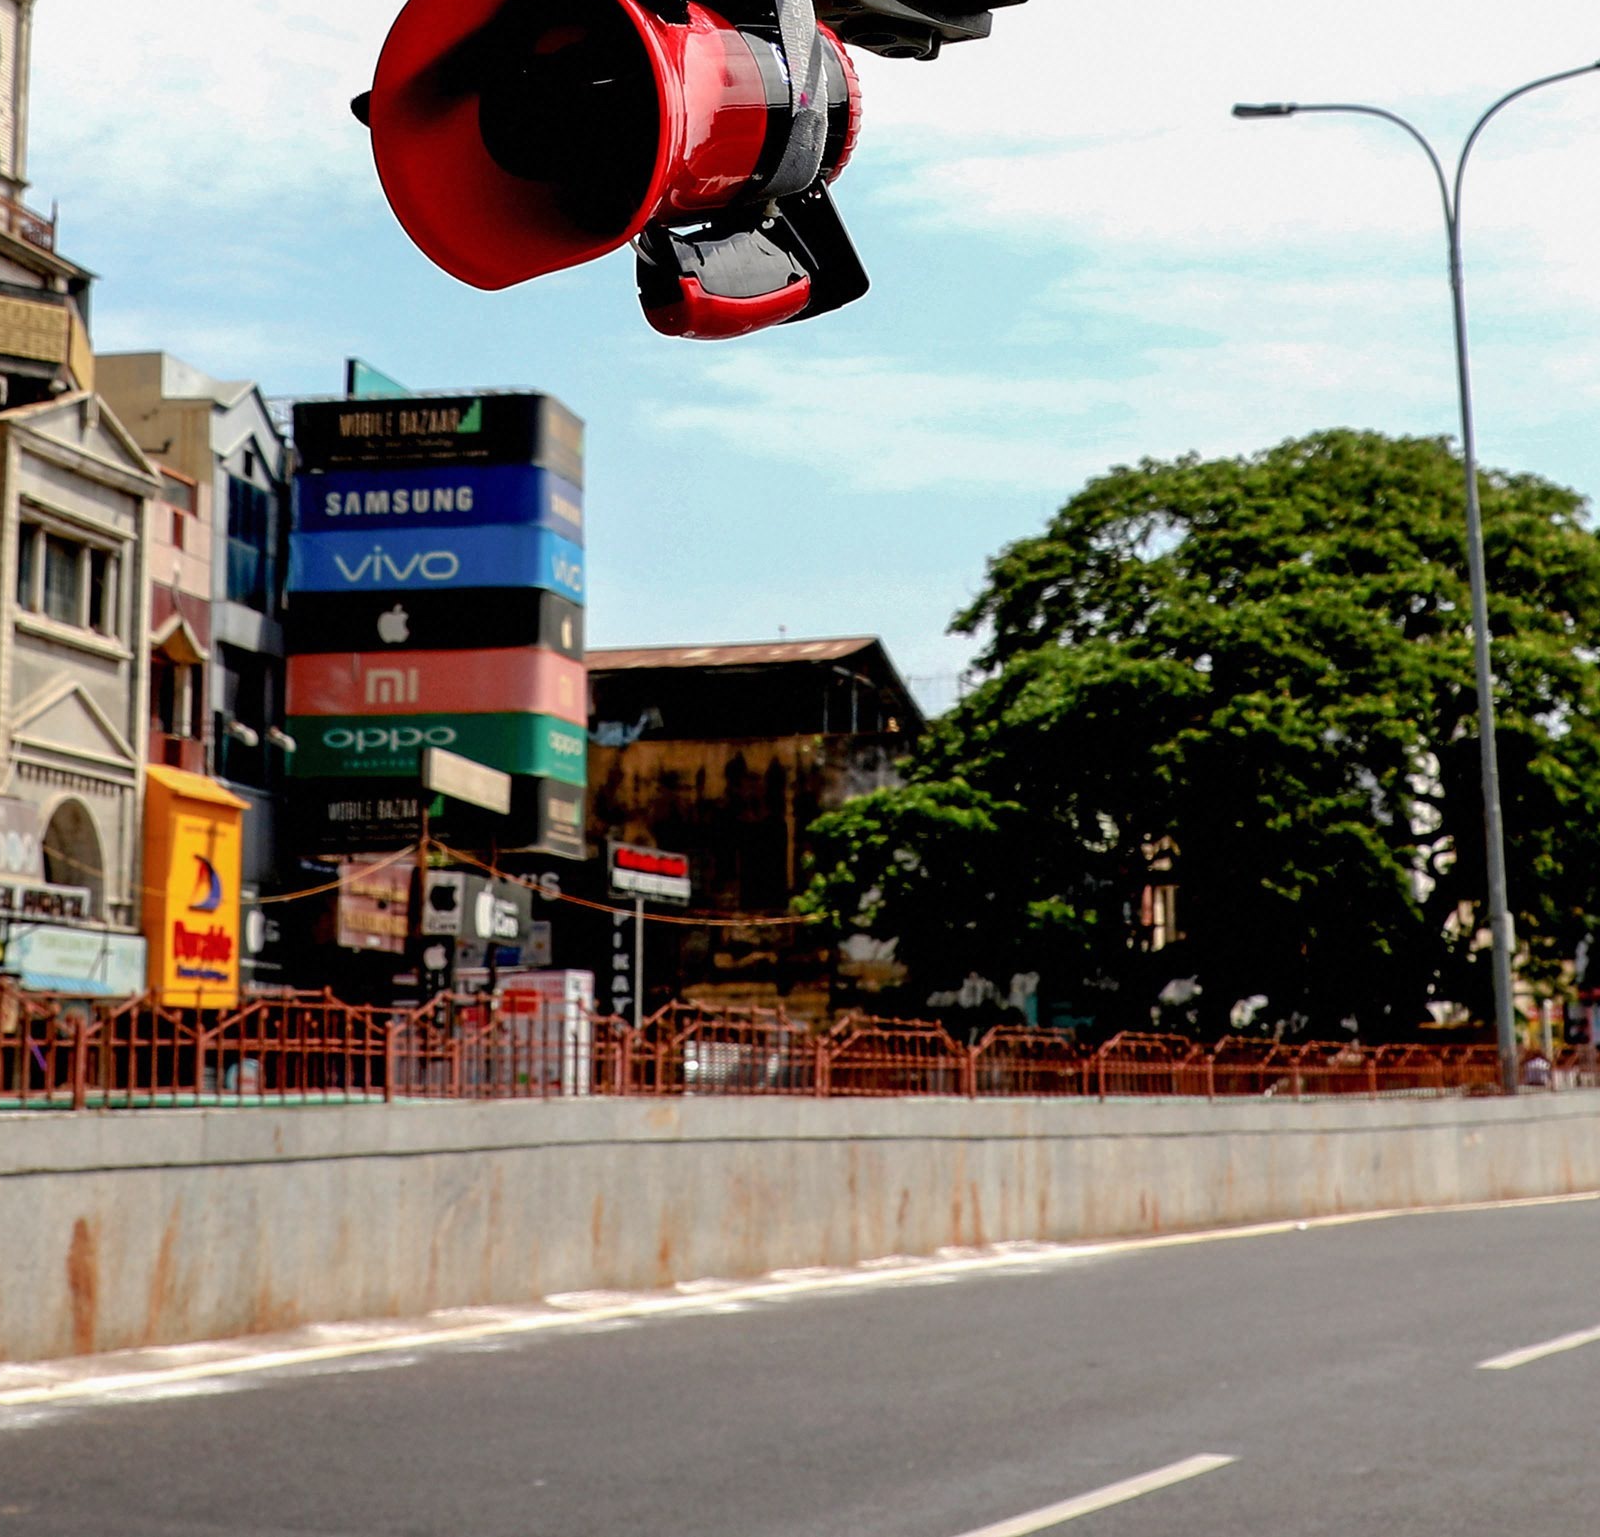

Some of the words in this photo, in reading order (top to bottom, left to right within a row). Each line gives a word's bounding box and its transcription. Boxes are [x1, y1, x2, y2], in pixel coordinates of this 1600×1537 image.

[338, 412, 393, 438] MOBILE
[399, 406, 462, 437] BAZAAR
[324, 485, 474, 517] SAMSUNG
[333, 545, 460, 583] vivo
[322, 726, 458, 755] oppo
